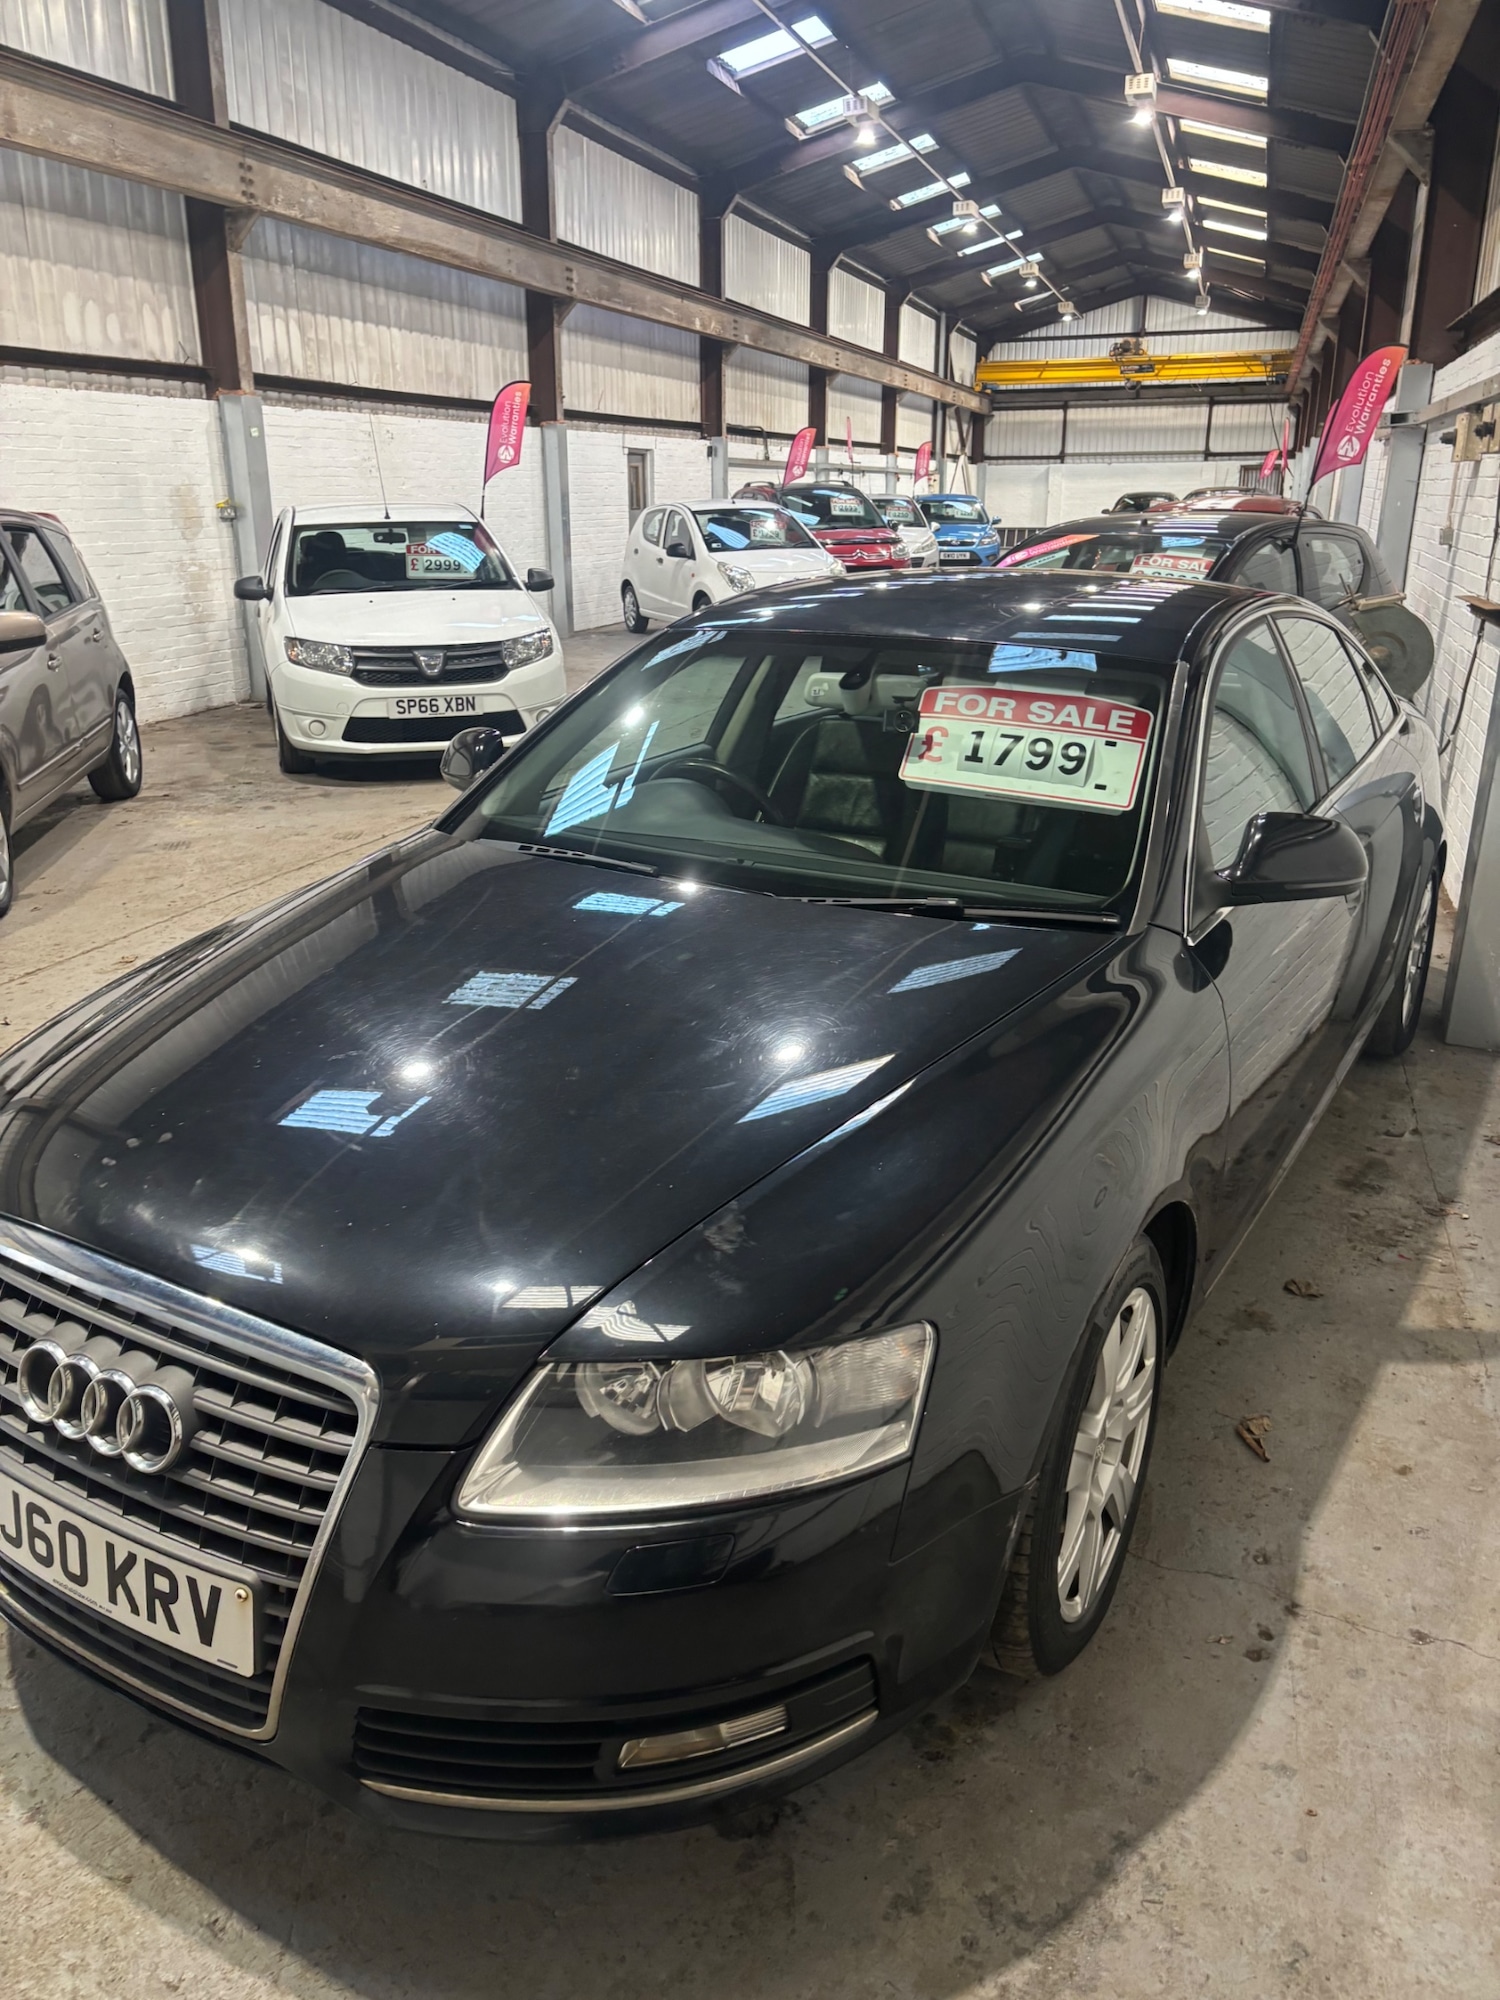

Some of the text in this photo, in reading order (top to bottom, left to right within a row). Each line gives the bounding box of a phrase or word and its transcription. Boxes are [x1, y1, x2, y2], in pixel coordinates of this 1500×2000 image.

[508, 391, 523, 445] Warranties
[1345, 371, 1374, 433] Evolution
[1354, 358, 1392, 435] Warranties
[499, 400, 512, 444] Evolution
[410, 558, 461, 571] £ 2999
[1139, 555, 1209, 572] FOR SAL
[395, 696, 476, 715] SP66 XBN
[933, 691, 1137, 735] FOR SALE
[917, 724, 1087, 776] £ 1799
[0, 1489, 223, 1648] J60 KRV
